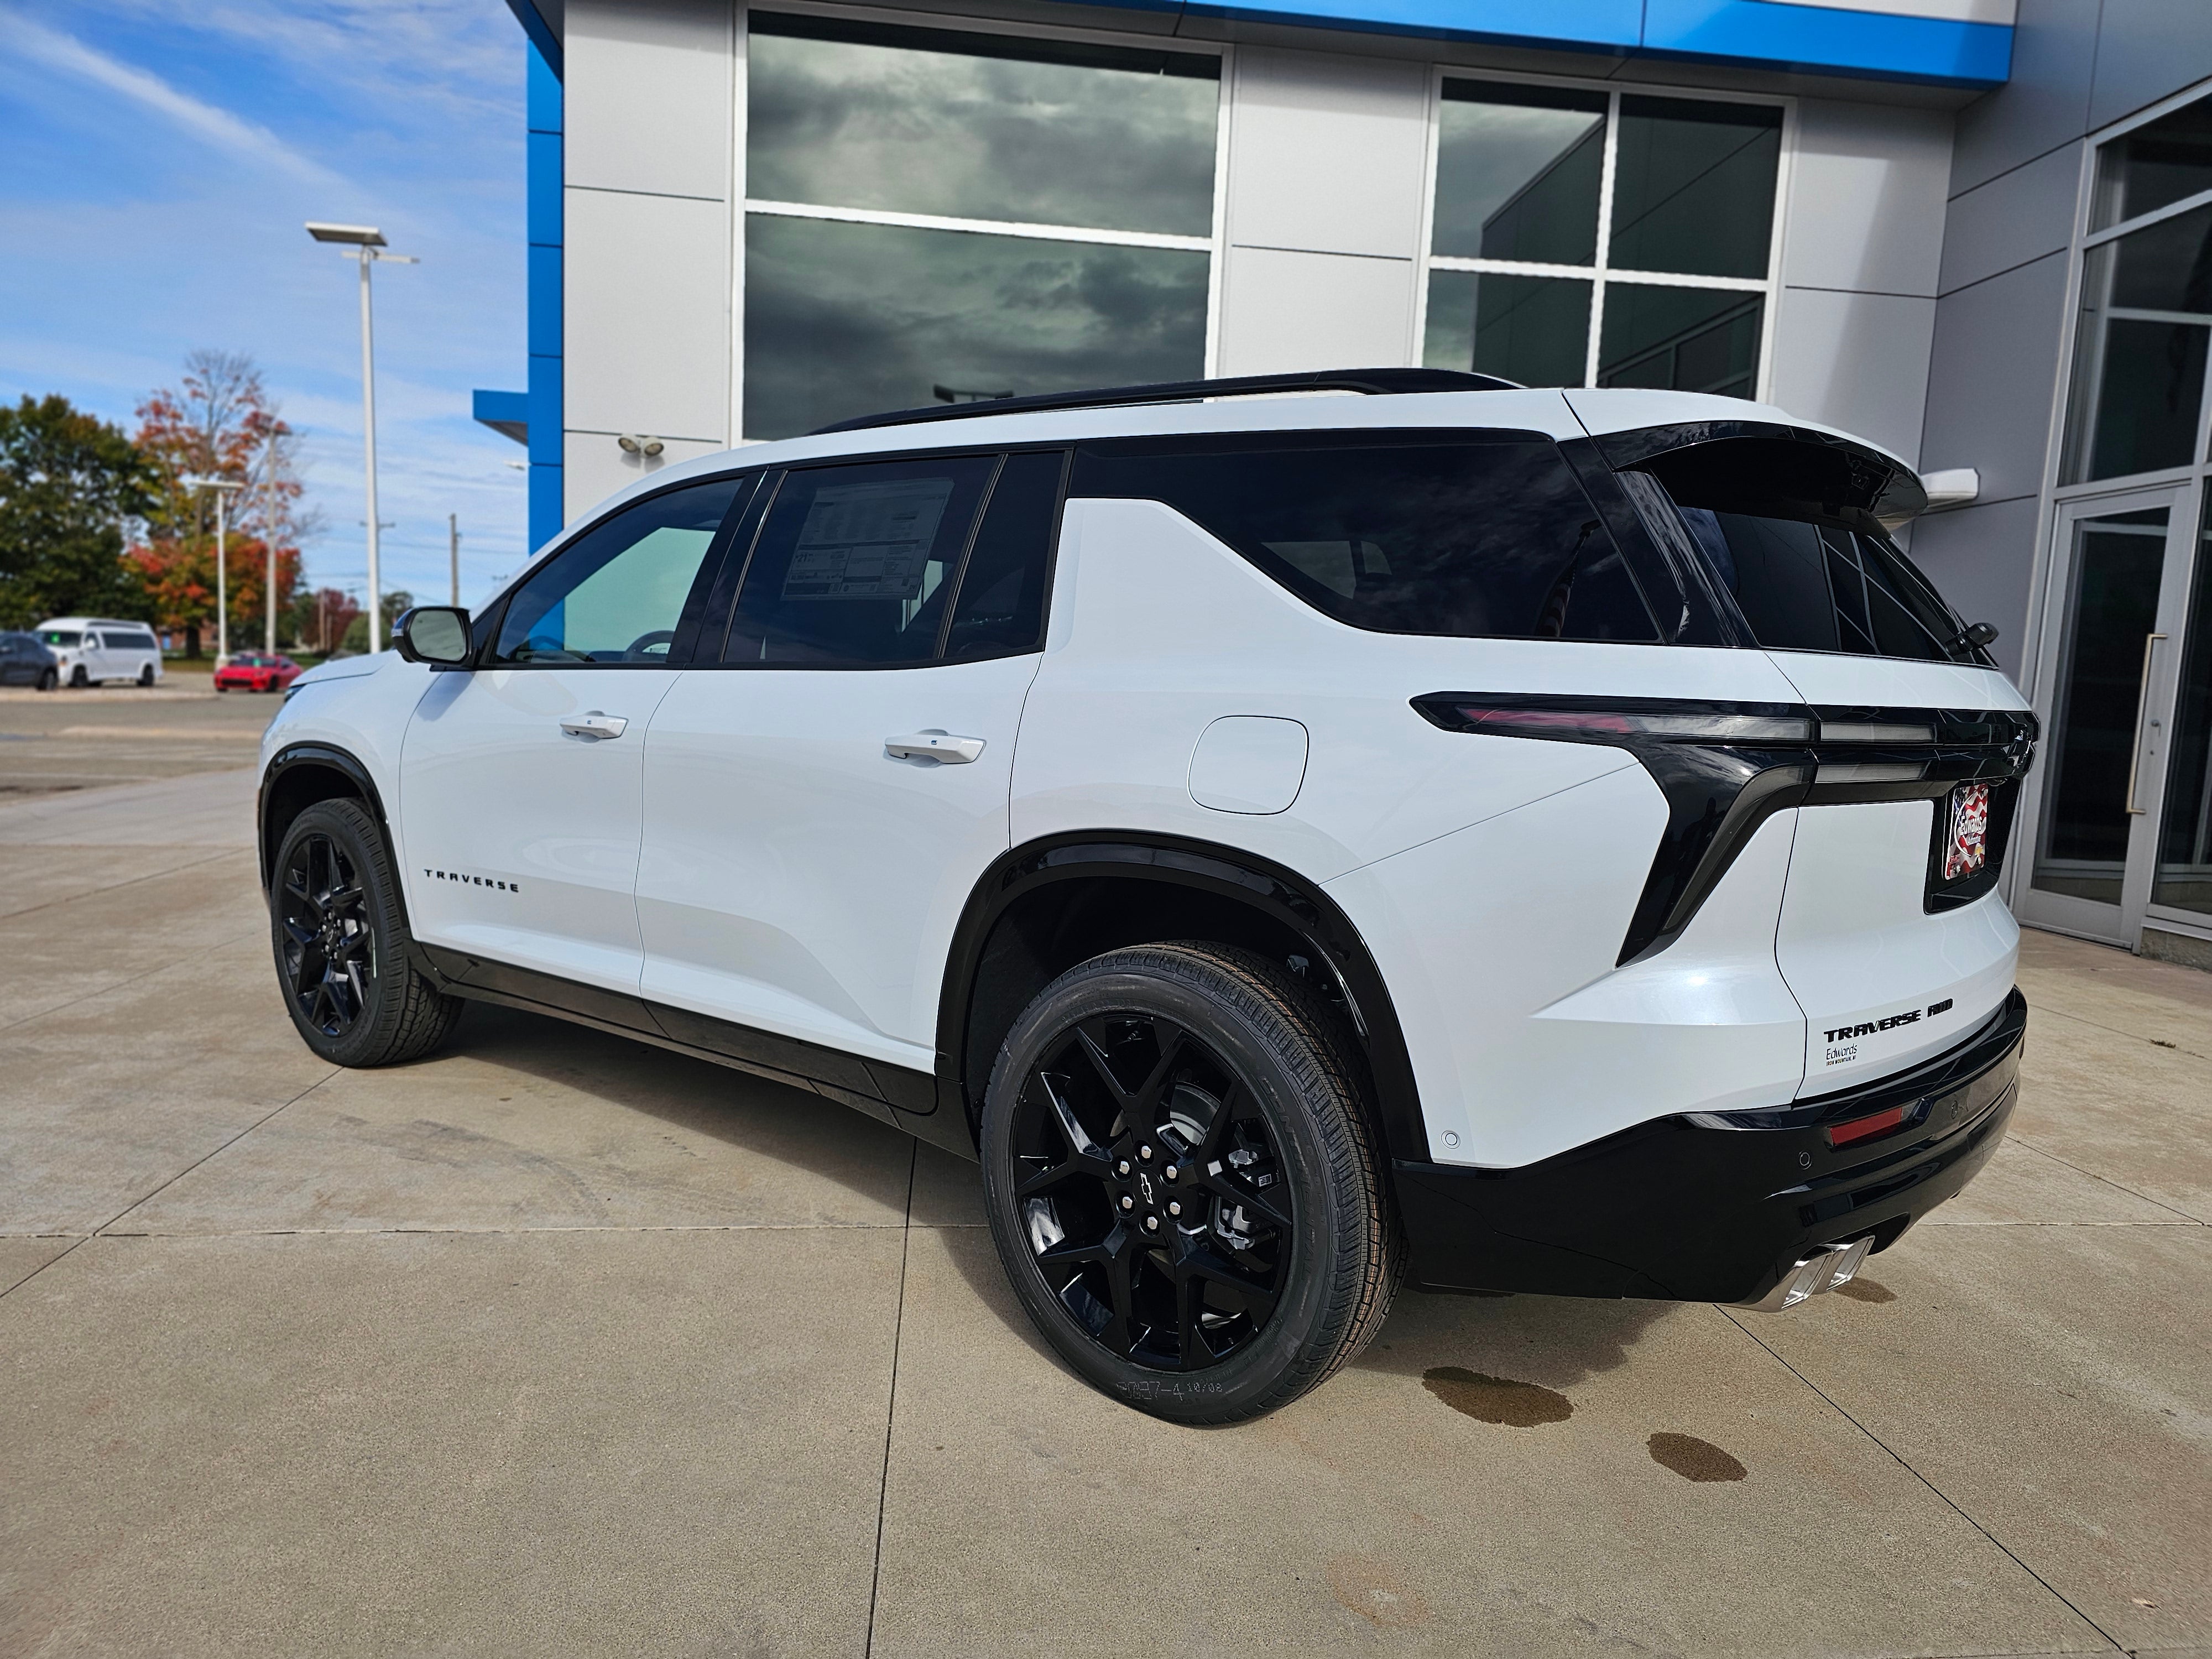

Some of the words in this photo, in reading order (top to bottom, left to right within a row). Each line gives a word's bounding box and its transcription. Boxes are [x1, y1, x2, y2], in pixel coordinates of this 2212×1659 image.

[1959, 812, 1983, 836] Edwards
[424, 869, 519, 893] TRAVERSE
[1927, 998, 1953, 1018] AWD
[1823, 1009, 1922, 1042] TRAVERSE
[1826, 1043, 1858, 1060] Edwards
[1258, 1075, 1316, 1282] CONTINENTAL
